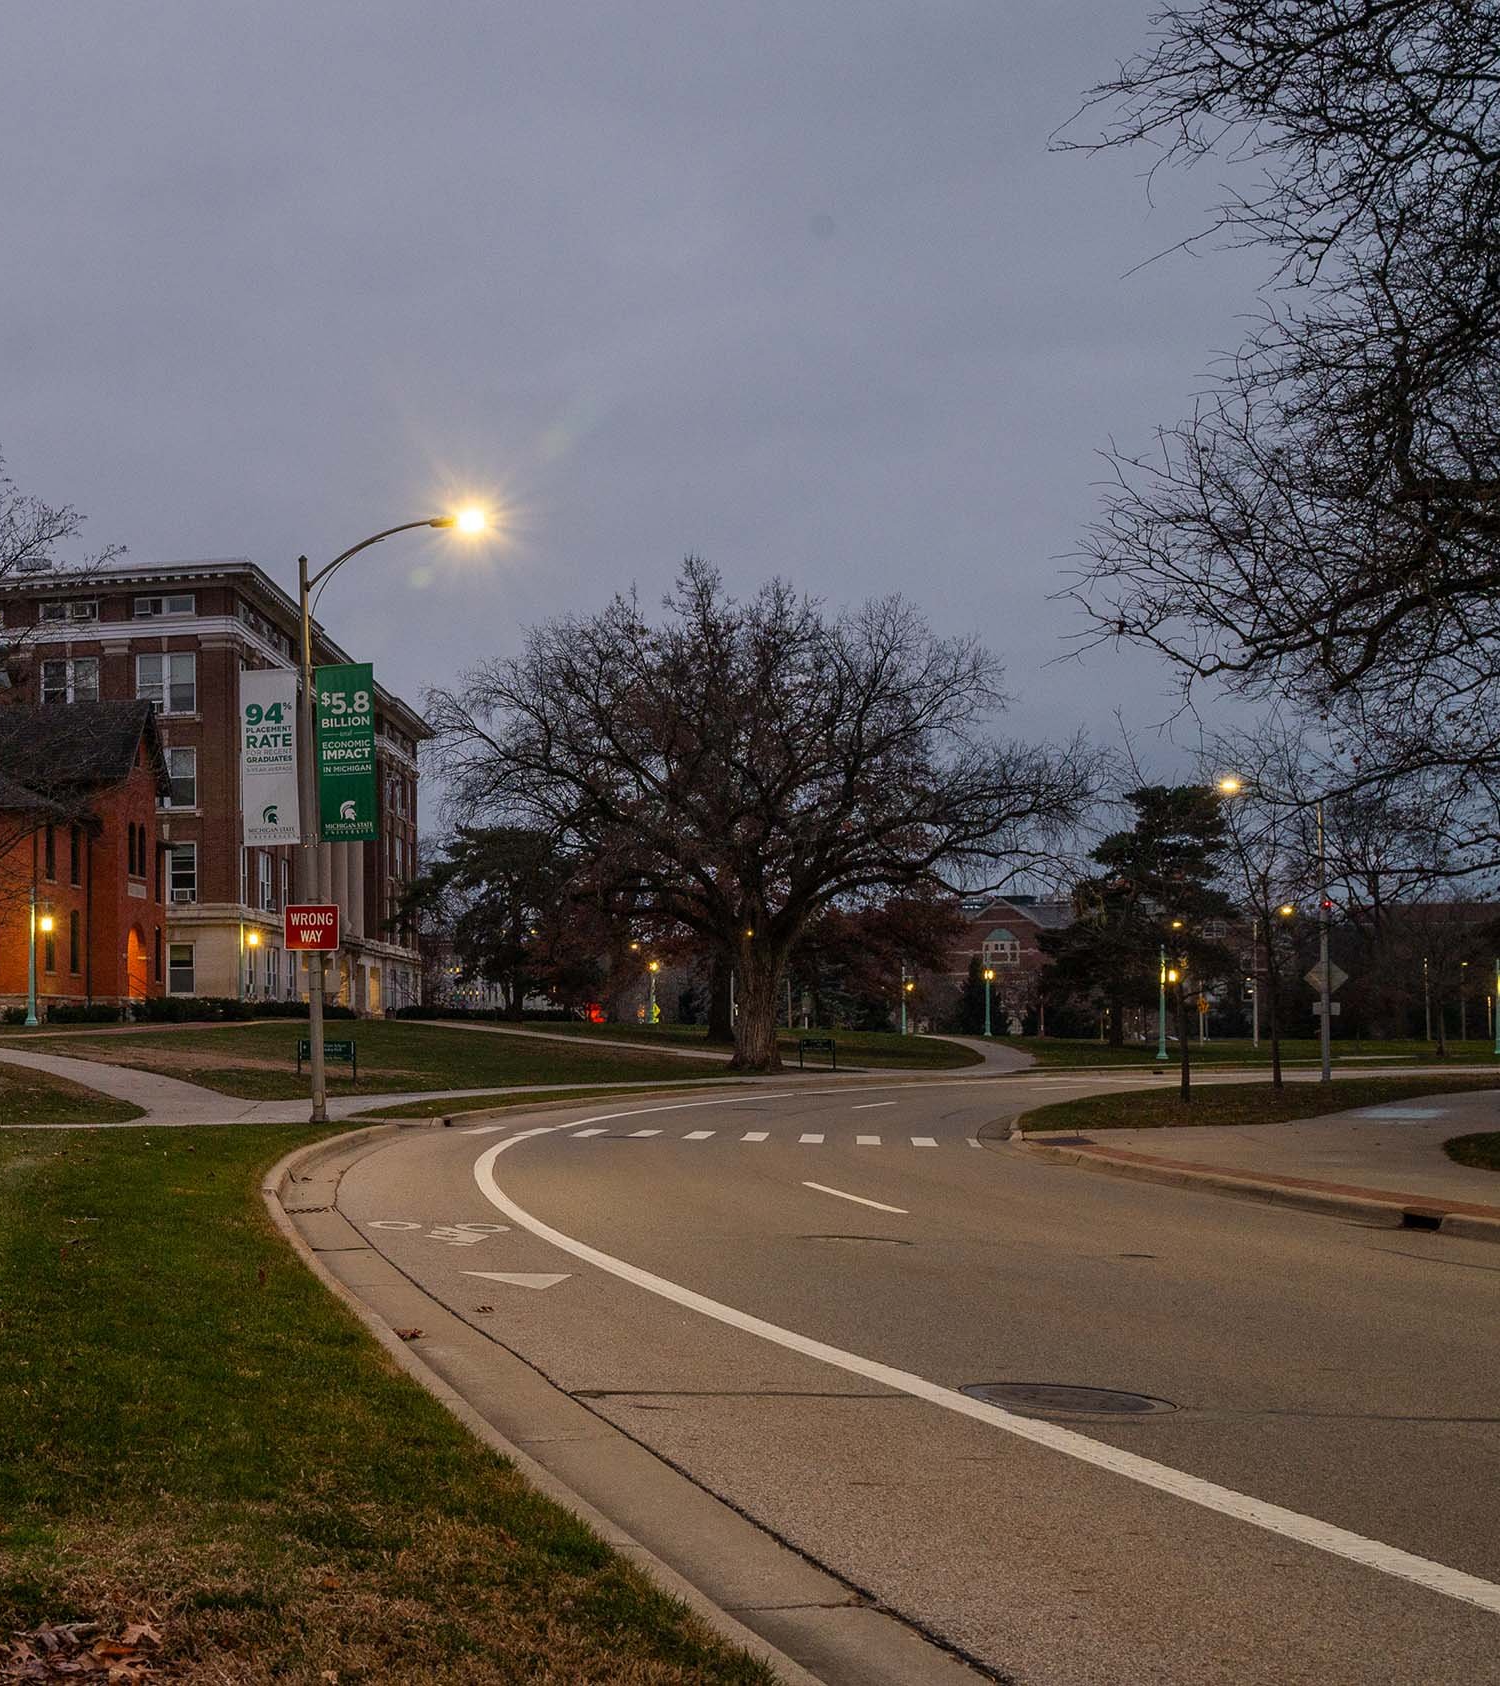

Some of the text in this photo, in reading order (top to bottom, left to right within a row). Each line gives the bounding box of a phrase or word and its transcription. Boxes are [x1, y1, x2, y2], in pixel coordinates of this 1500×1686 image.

[321, 716, 370, 729] BILLION
[246, 725, 292, 734] PLACEMENT
[246, 733, 292, 749] RATE
[322, 739, 371, 749] ECONOMIC
[323, 747, 371, 760] IMPACT
[246, 755, 292, 764] GRADUATES
[333, 764, 372, 773] MICHIGAN
[325, 822, 356, 830] MICHIGAN
[290, 912, 333, 926] WRONG
[300, 930, 323, 943] WAY
